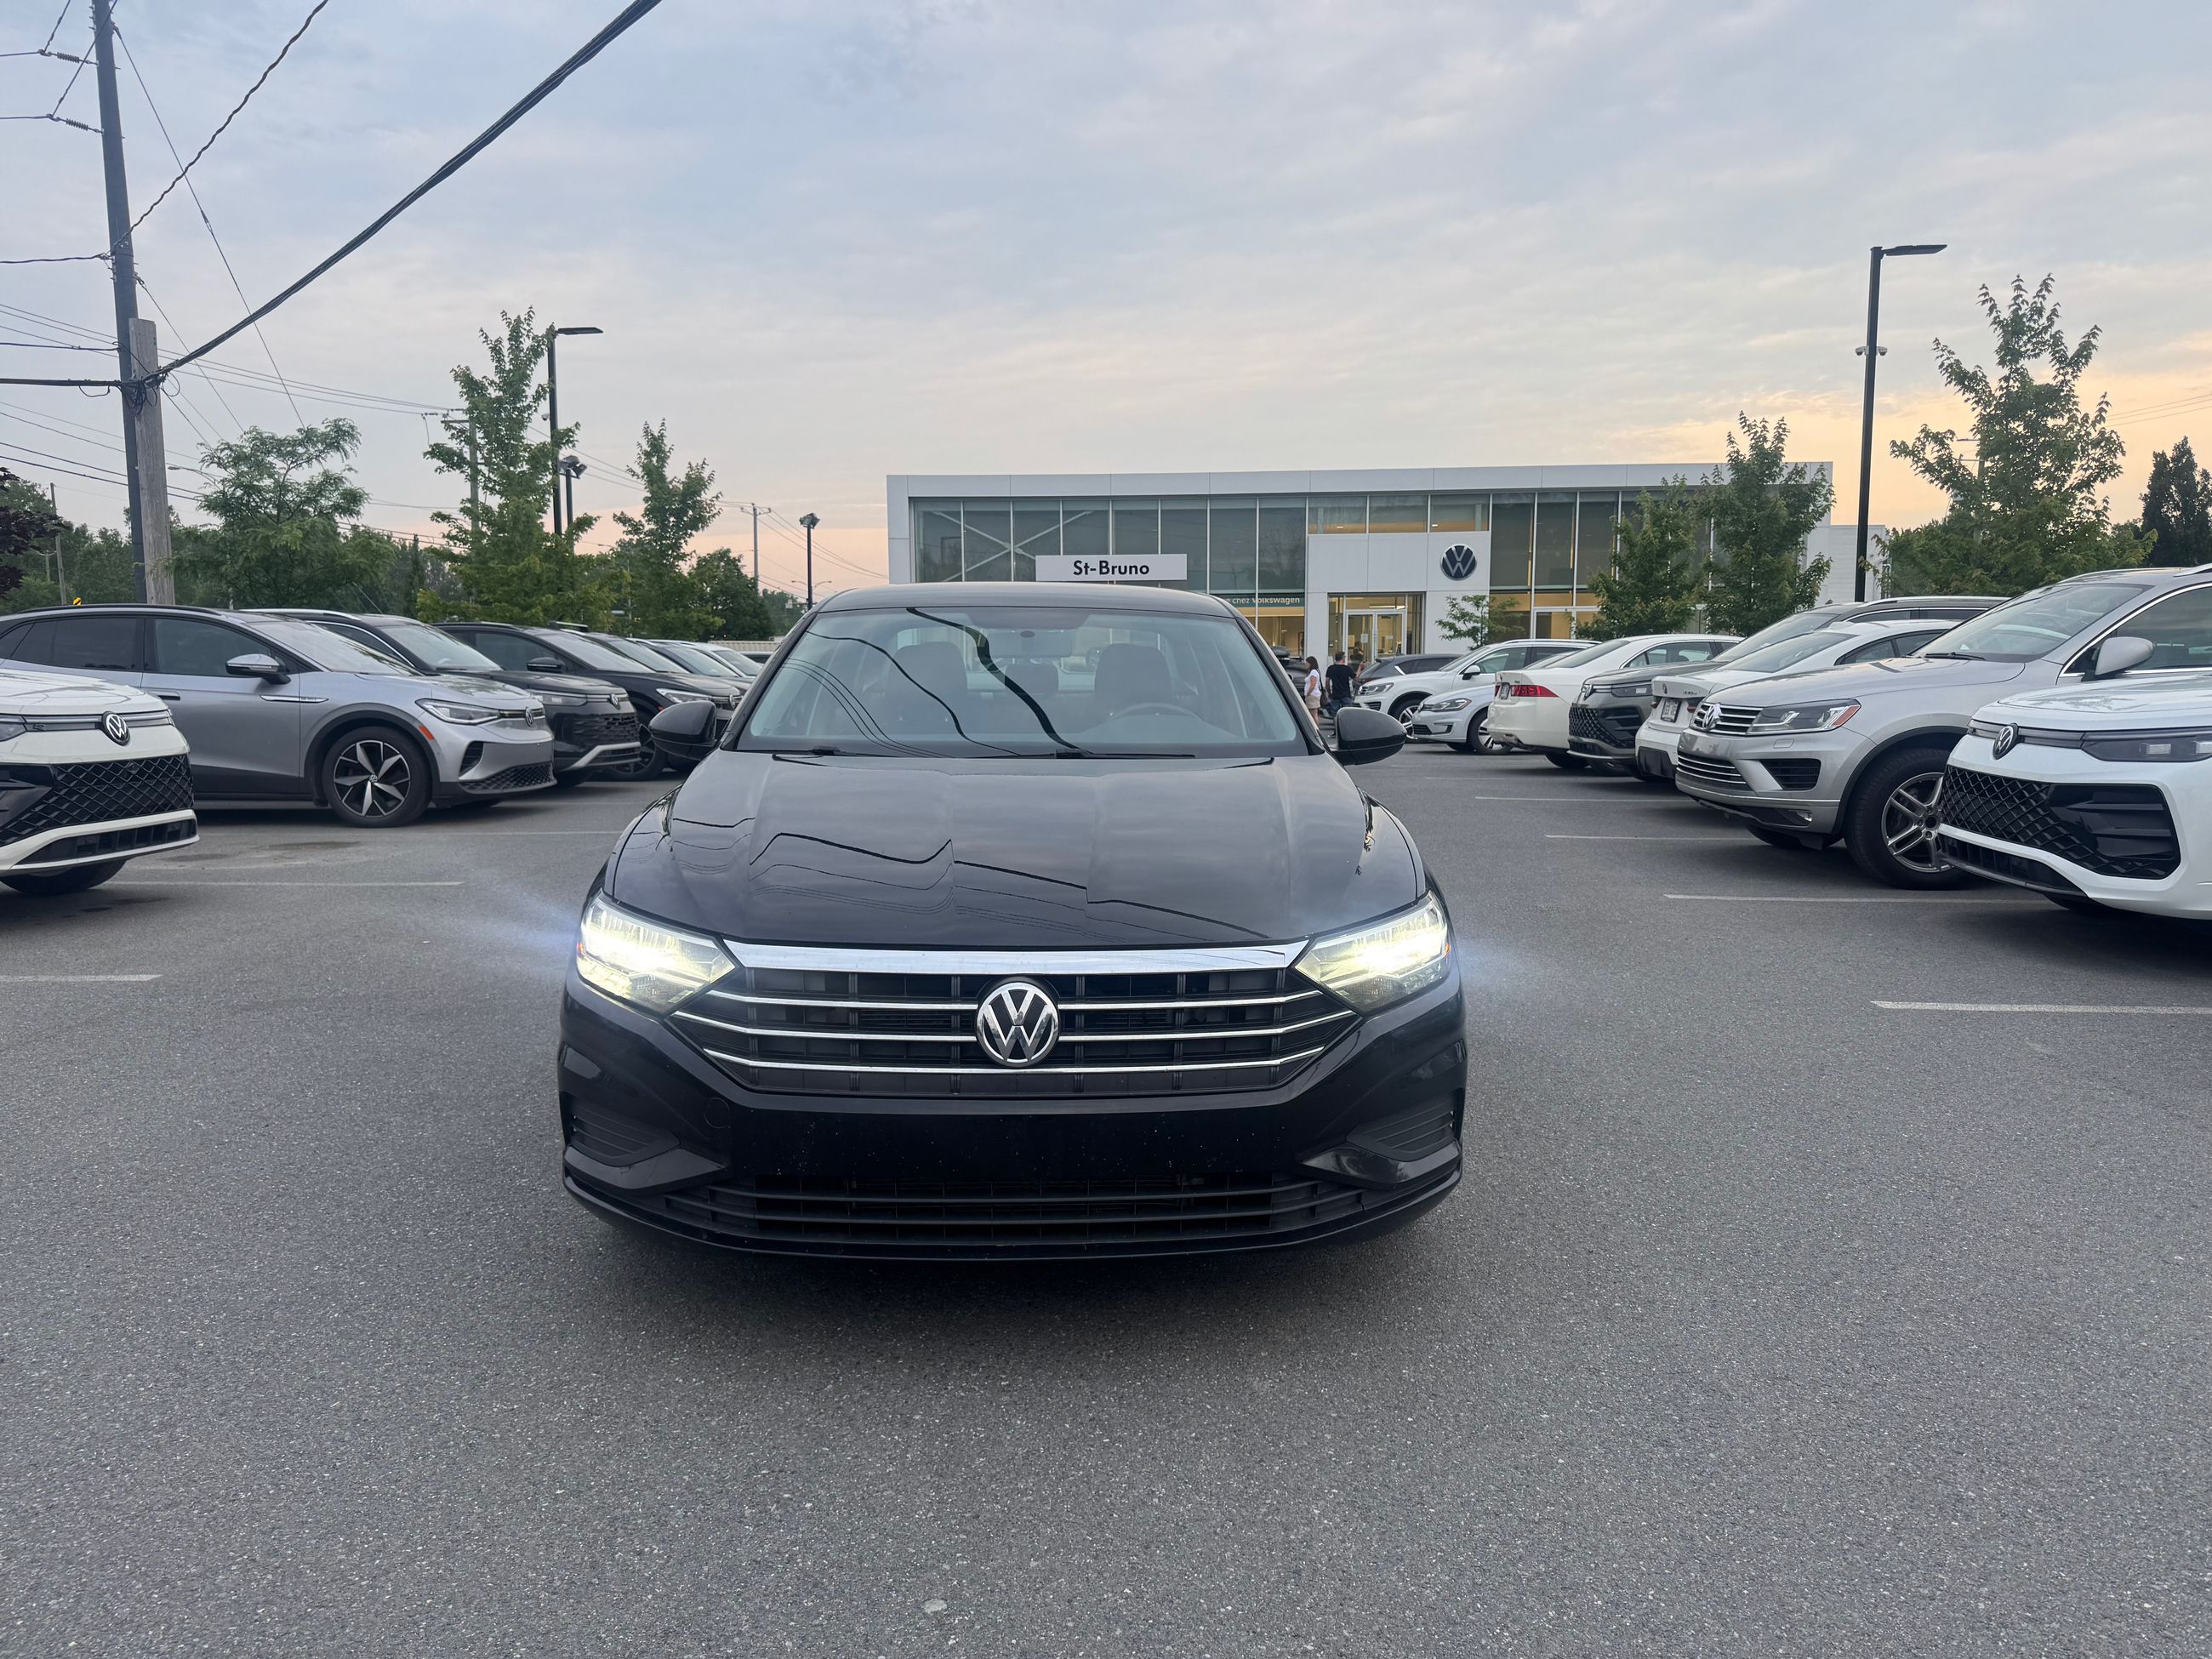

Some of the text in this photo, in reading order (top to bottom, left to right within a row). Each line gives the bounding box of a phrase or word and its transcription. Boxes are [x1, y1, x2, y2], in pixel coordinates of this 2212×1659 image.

[1073, 560, 1150, 576] St-Bruno
[1441, 544, 1476, 579] VW
[105, 712, 128, 740] VW
[1993, 725, 2014, 757] VW
[978, 980, 1057, 1063] VW
